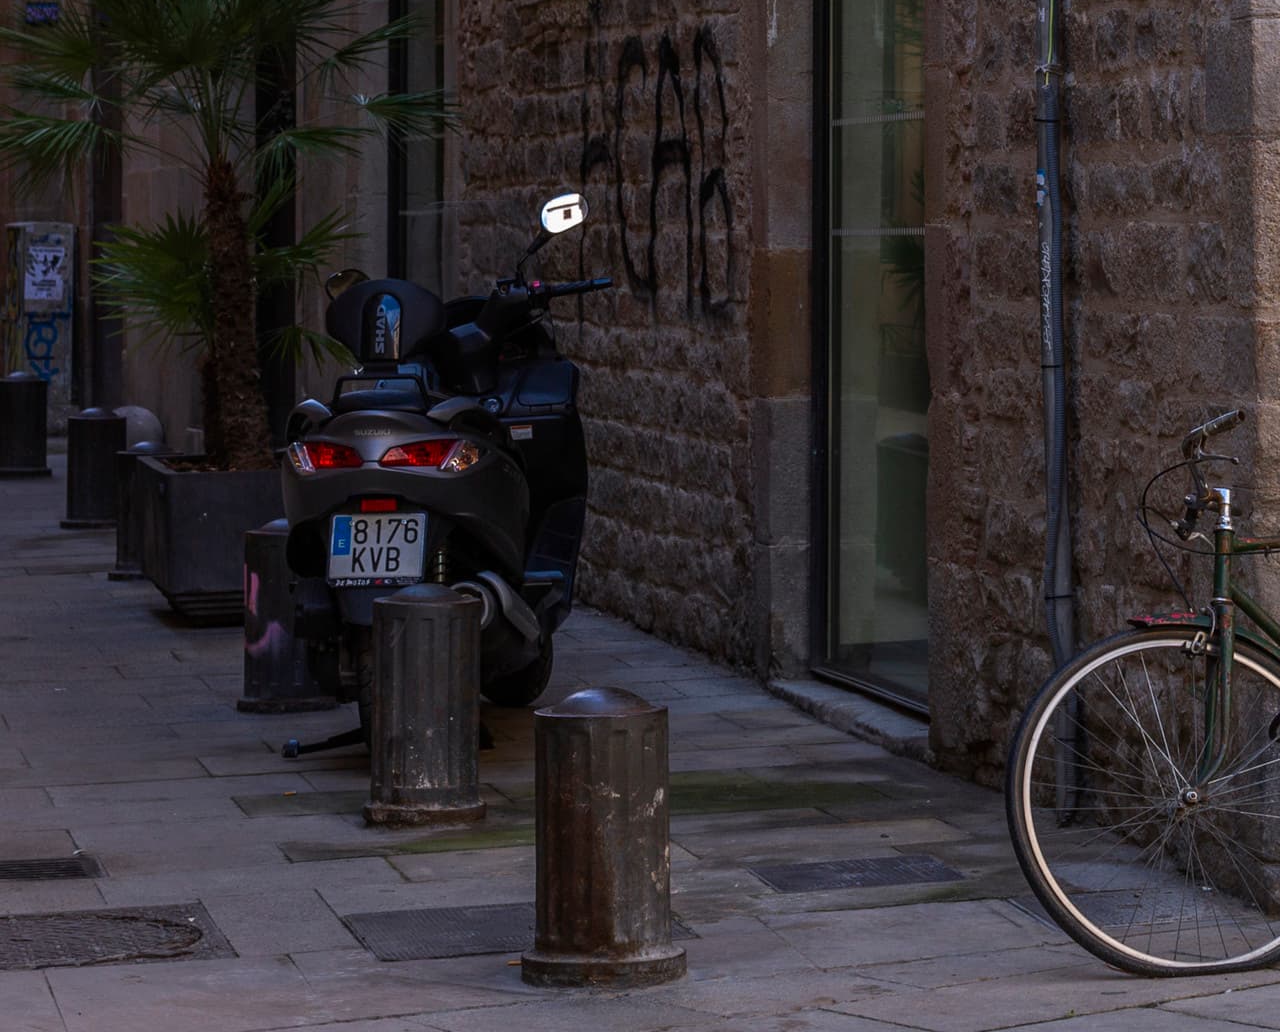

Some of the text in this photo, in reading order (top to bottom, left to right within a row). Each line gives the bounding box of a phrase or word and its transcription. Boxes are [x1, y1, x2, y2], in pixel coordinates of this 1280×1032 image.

[375, 304, 386, 354] SHAD
[338, 539, 345, 548] E
[353, 518, 419, 545] 8176
[351, 547, 400, 573] KVB
